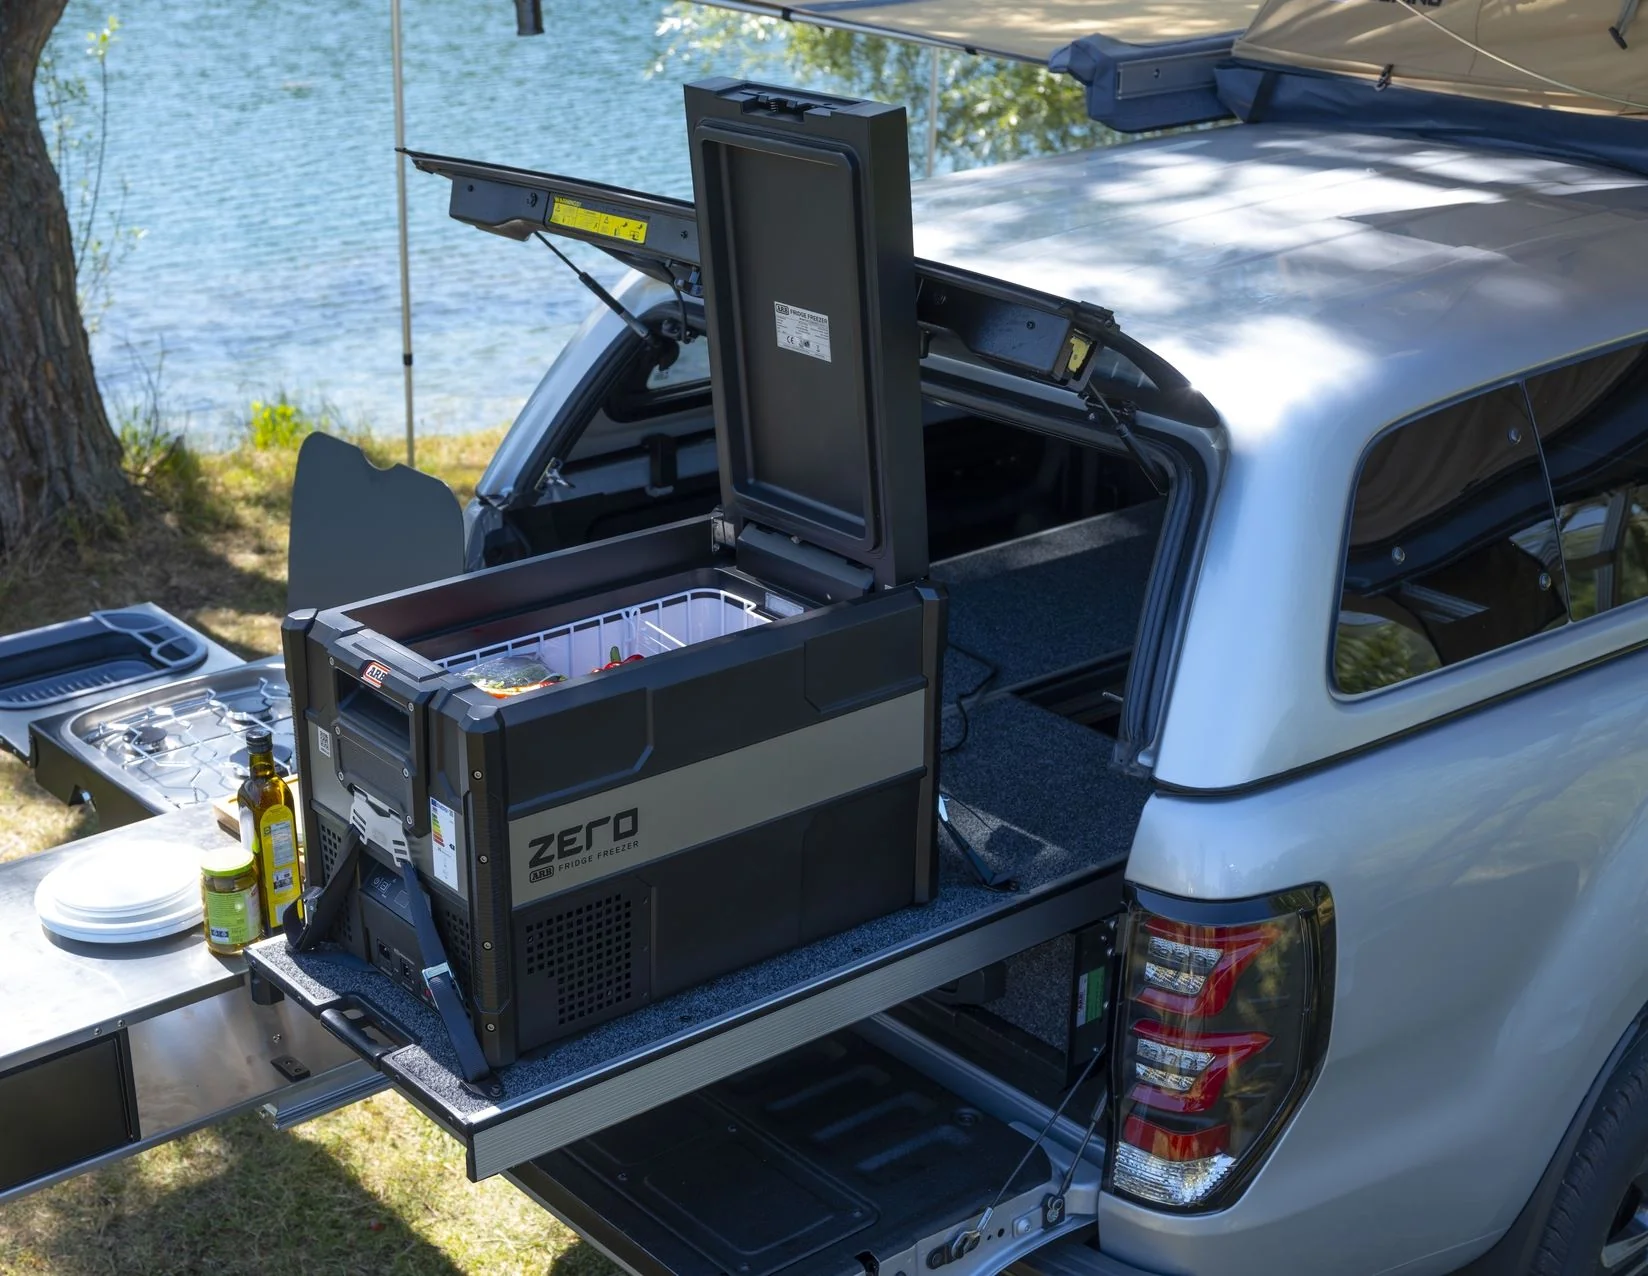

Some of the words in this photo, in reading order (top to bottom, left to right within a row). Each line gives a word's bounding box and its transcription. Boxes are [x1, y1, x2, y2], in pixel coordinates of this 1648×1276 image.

[790, 309, 806, 318] FRIDGE
[808, 314, 828, 323] FREEZER
[530, 866, 554, 882] ARB
[558, 855, 593, 872] FRIDGE
[597, 841, 639, 860] FREEZER
